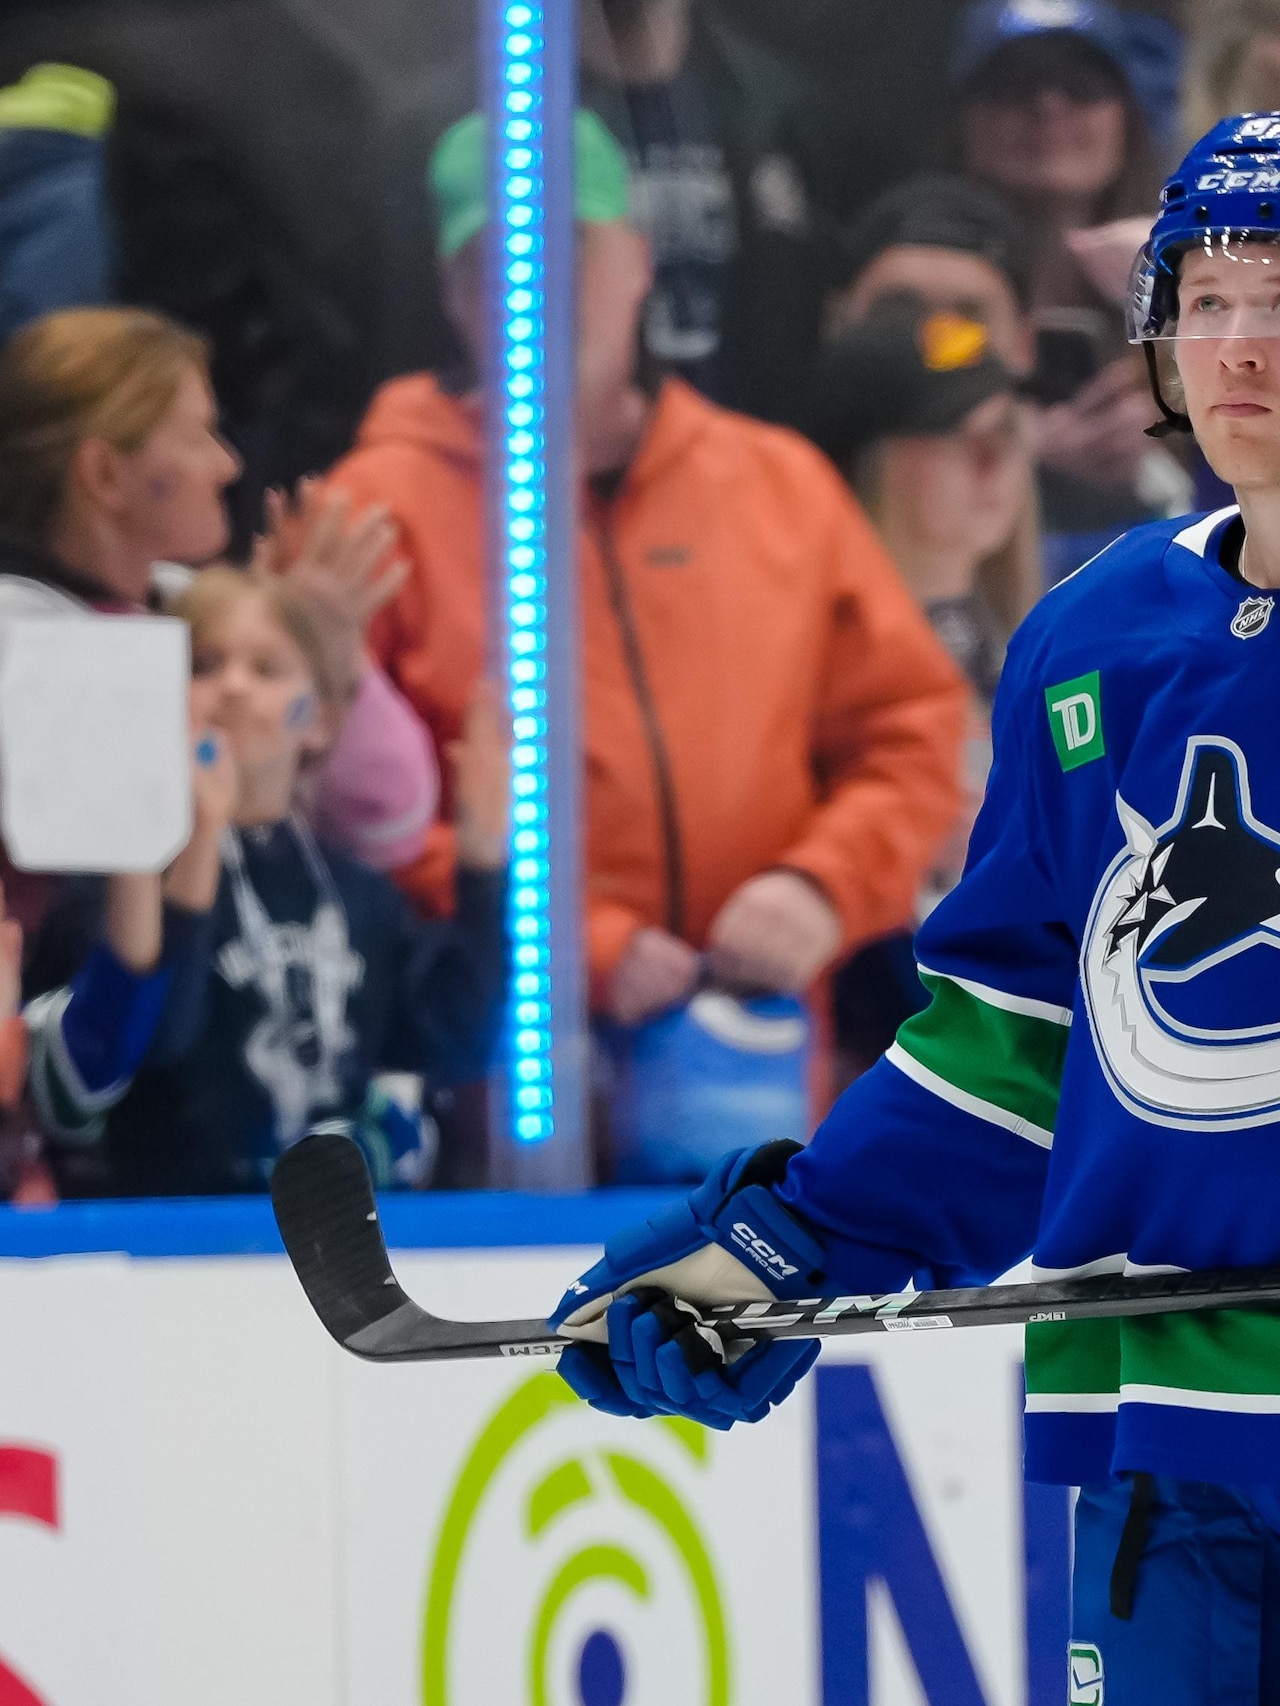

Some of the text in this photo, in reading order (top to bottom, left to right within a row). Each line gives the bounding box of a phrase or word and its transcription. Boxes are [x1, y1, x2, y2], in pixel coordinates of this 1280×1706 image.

[1052, 692, 1096, 751] TD
[732, 1222, 799, 1276] CCM
[806, 1358, 1072, 1706] N
